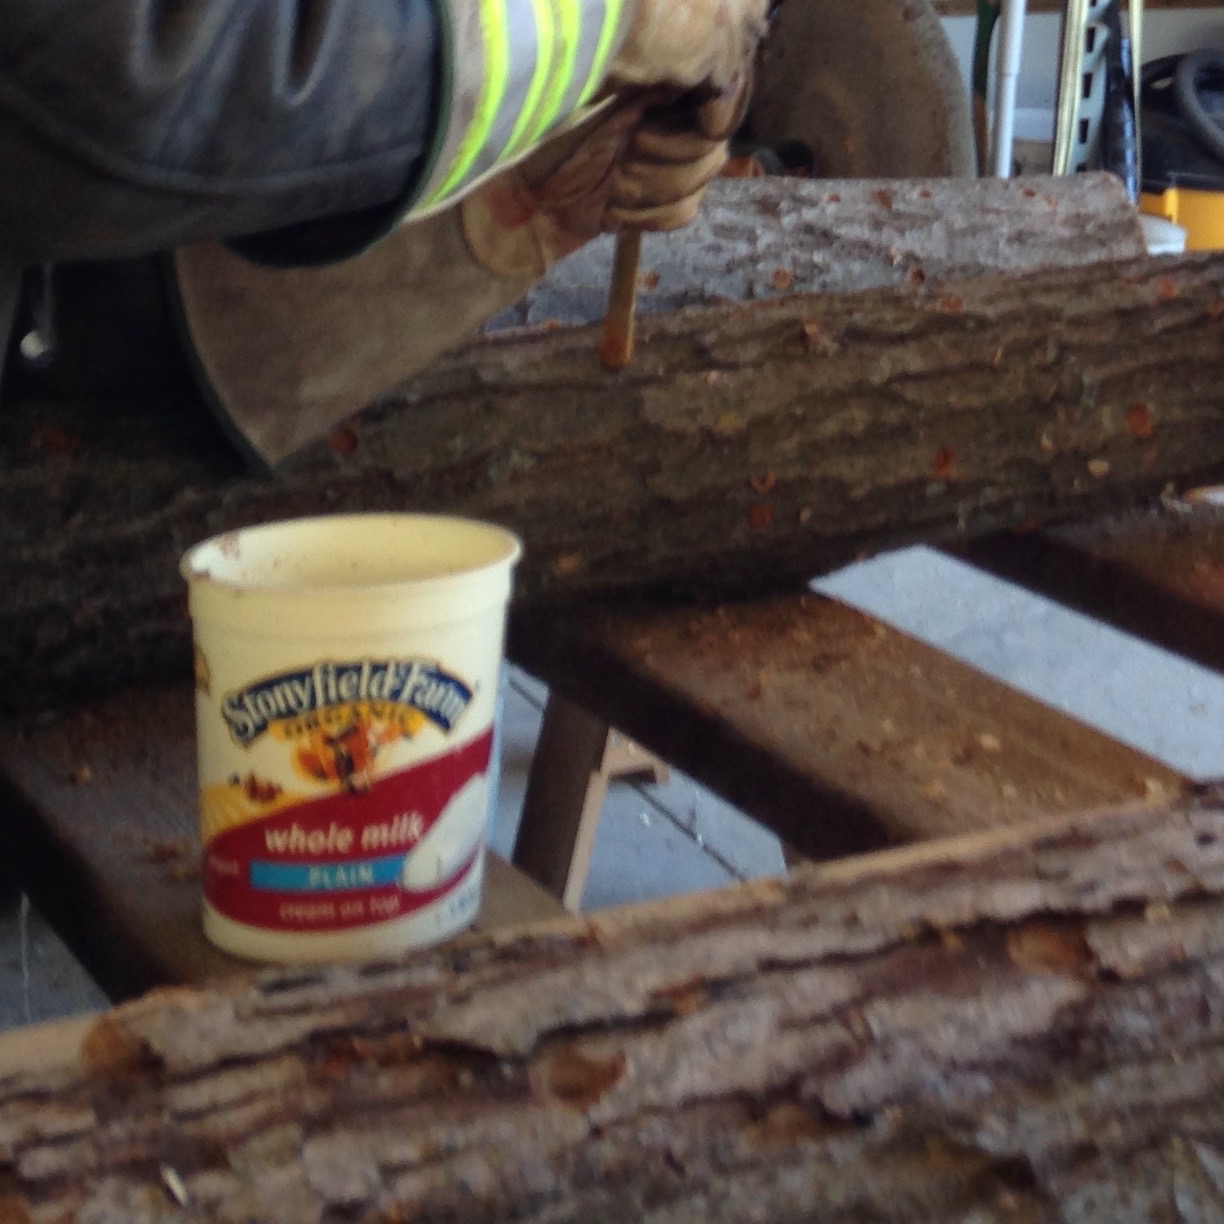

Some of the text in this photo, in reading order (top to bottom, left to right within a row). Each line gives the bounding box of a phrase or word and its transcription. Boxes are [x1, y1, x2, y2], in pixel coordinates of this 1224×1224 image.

[222, 660, 471, 742] Stonyfield Farm
[264, 810, 424, 855] whole milk
[308, 863, 374, 889] PLAIN
